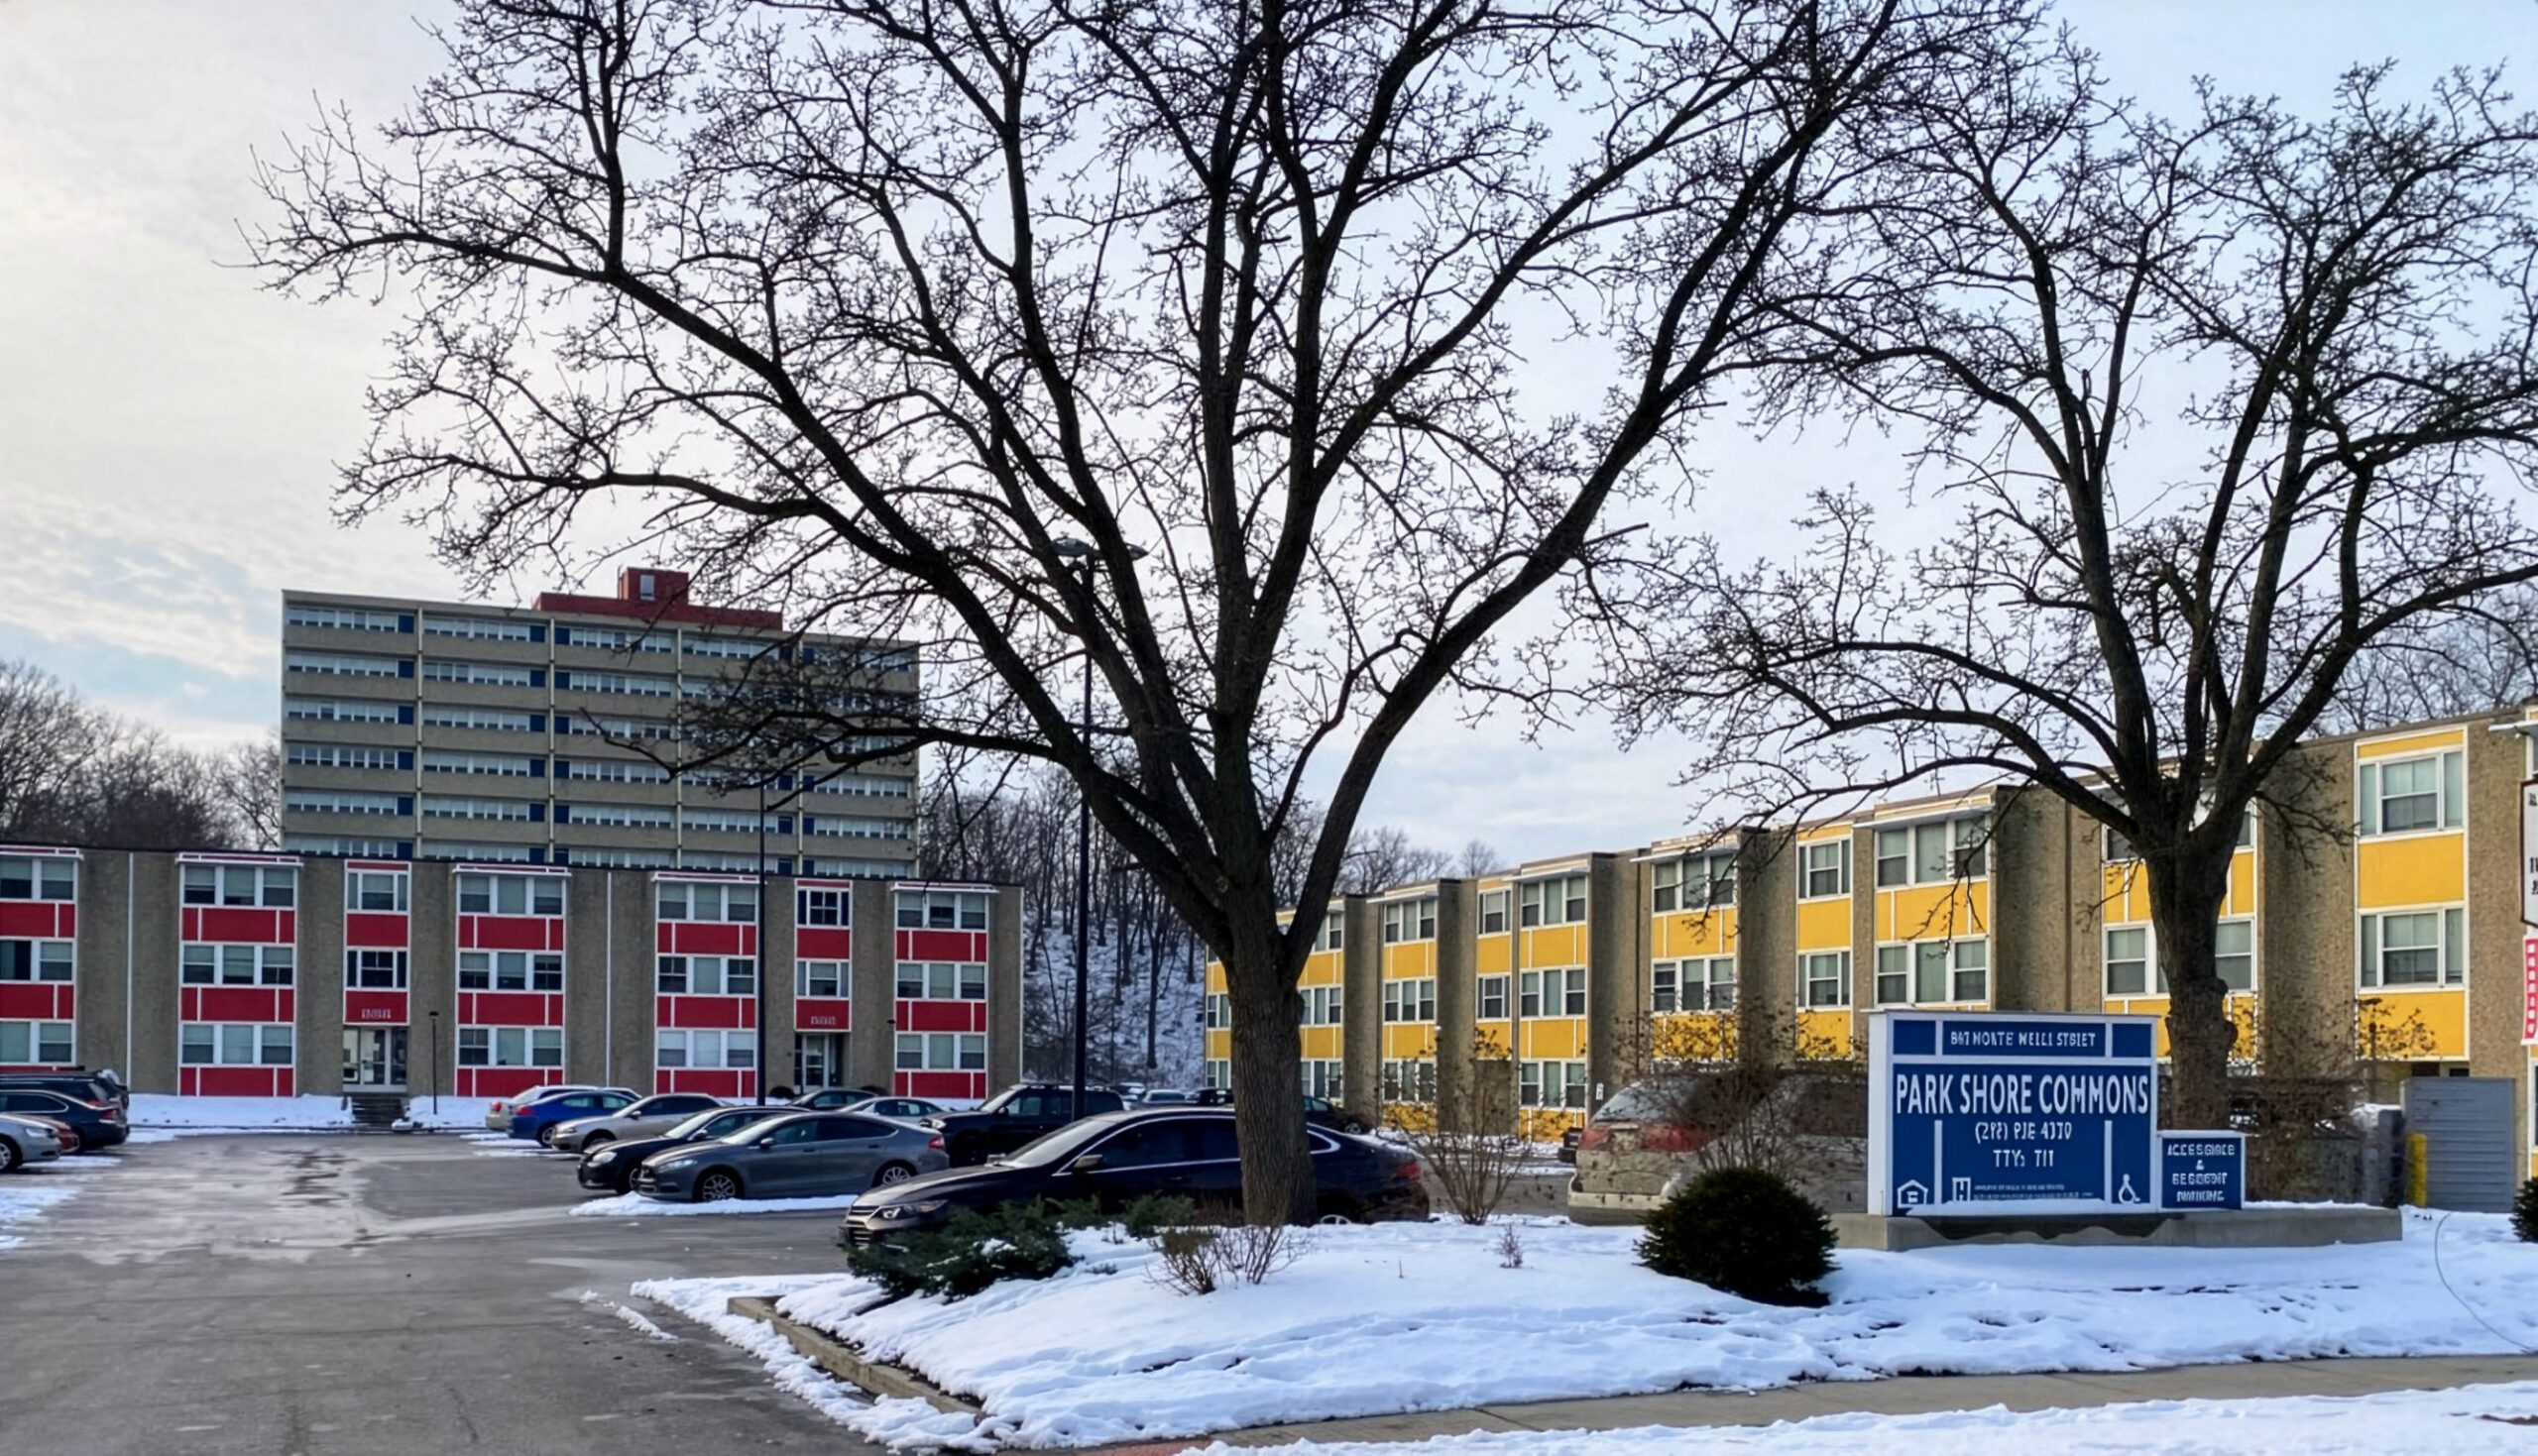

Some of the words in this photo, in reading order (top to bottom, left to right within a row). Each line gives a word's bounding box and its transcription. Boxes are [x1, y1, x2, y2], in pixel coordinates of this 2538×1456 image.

[1896, 1073, 1954, 1114] PARK
[1959, 1073, 2032, 1114] SHORE
[2038, 1073, 2148, 1114] COMMONS
